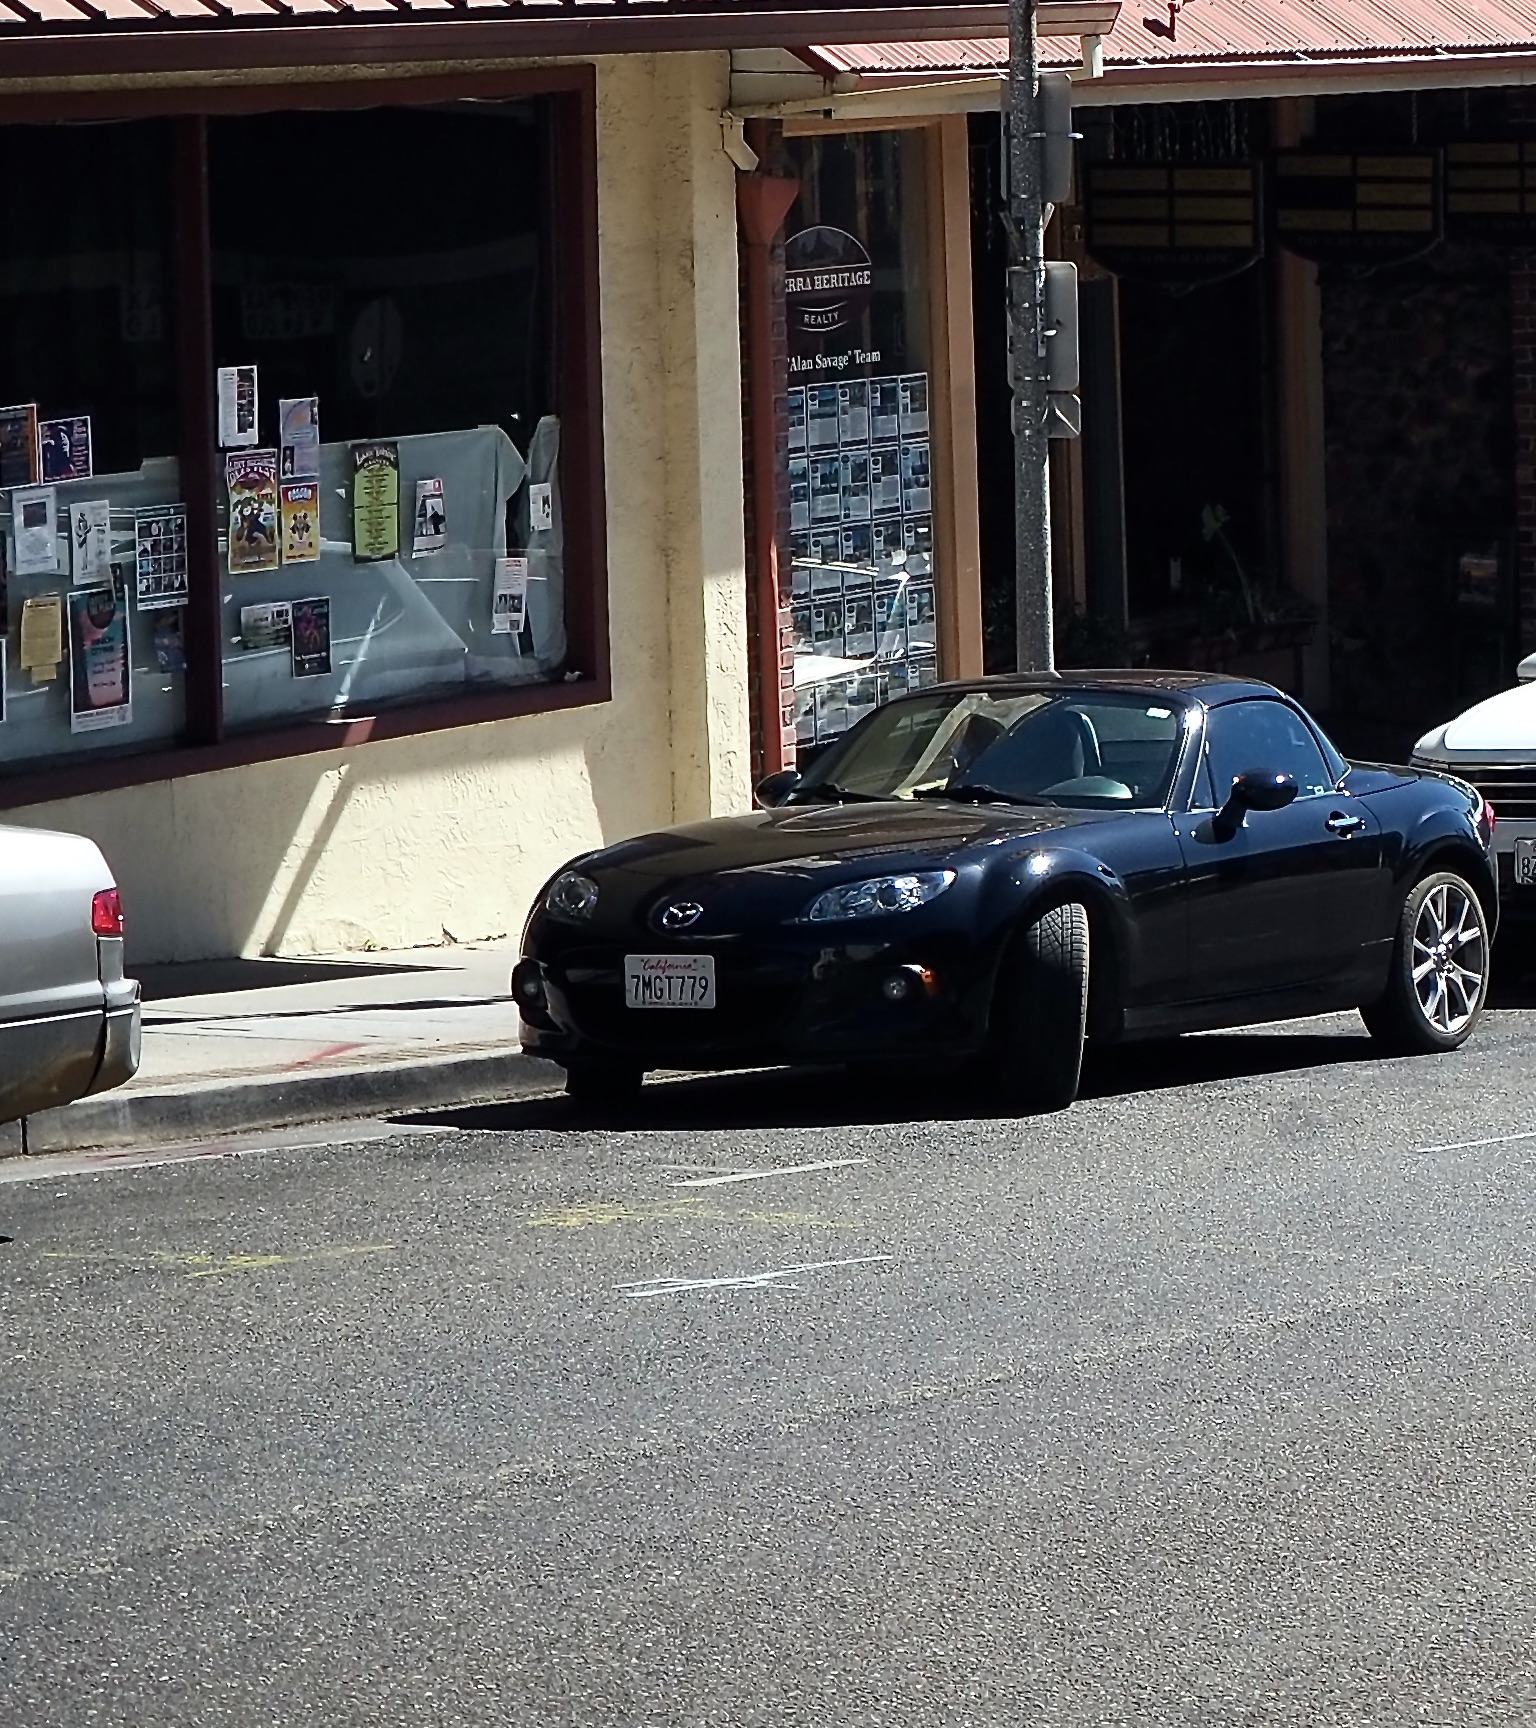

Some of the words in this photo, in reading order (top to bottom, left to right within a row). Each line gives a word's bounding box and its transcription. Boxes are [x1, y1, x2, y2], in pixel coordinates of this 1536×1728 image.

[814, 270, 871, 289] HERITAGE
[803, 311, 839, 324] REALTY
[853, 348, 881, 364] Team
[630, 974, 709, 1001] 7MGT779
